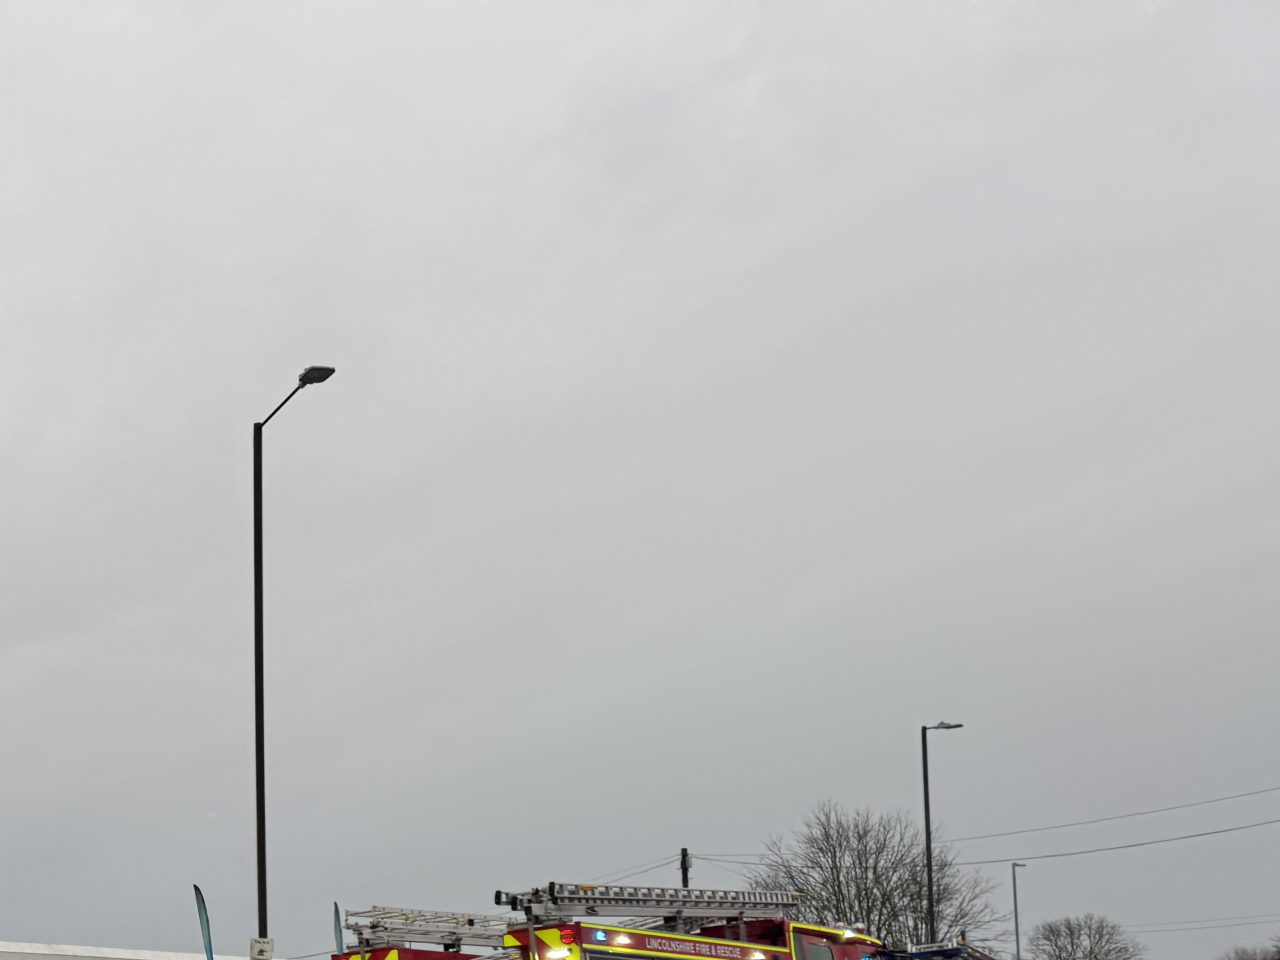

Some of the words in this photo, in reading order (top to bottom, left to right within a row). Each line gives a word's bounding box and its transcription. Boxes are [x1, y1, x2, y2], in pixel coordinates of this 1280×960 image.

[645, 937, 696, 954] LINCOLNSHIRE
[695, 942, 711, 955] FIRE
[716, 945, 741, 958] RESCUE
